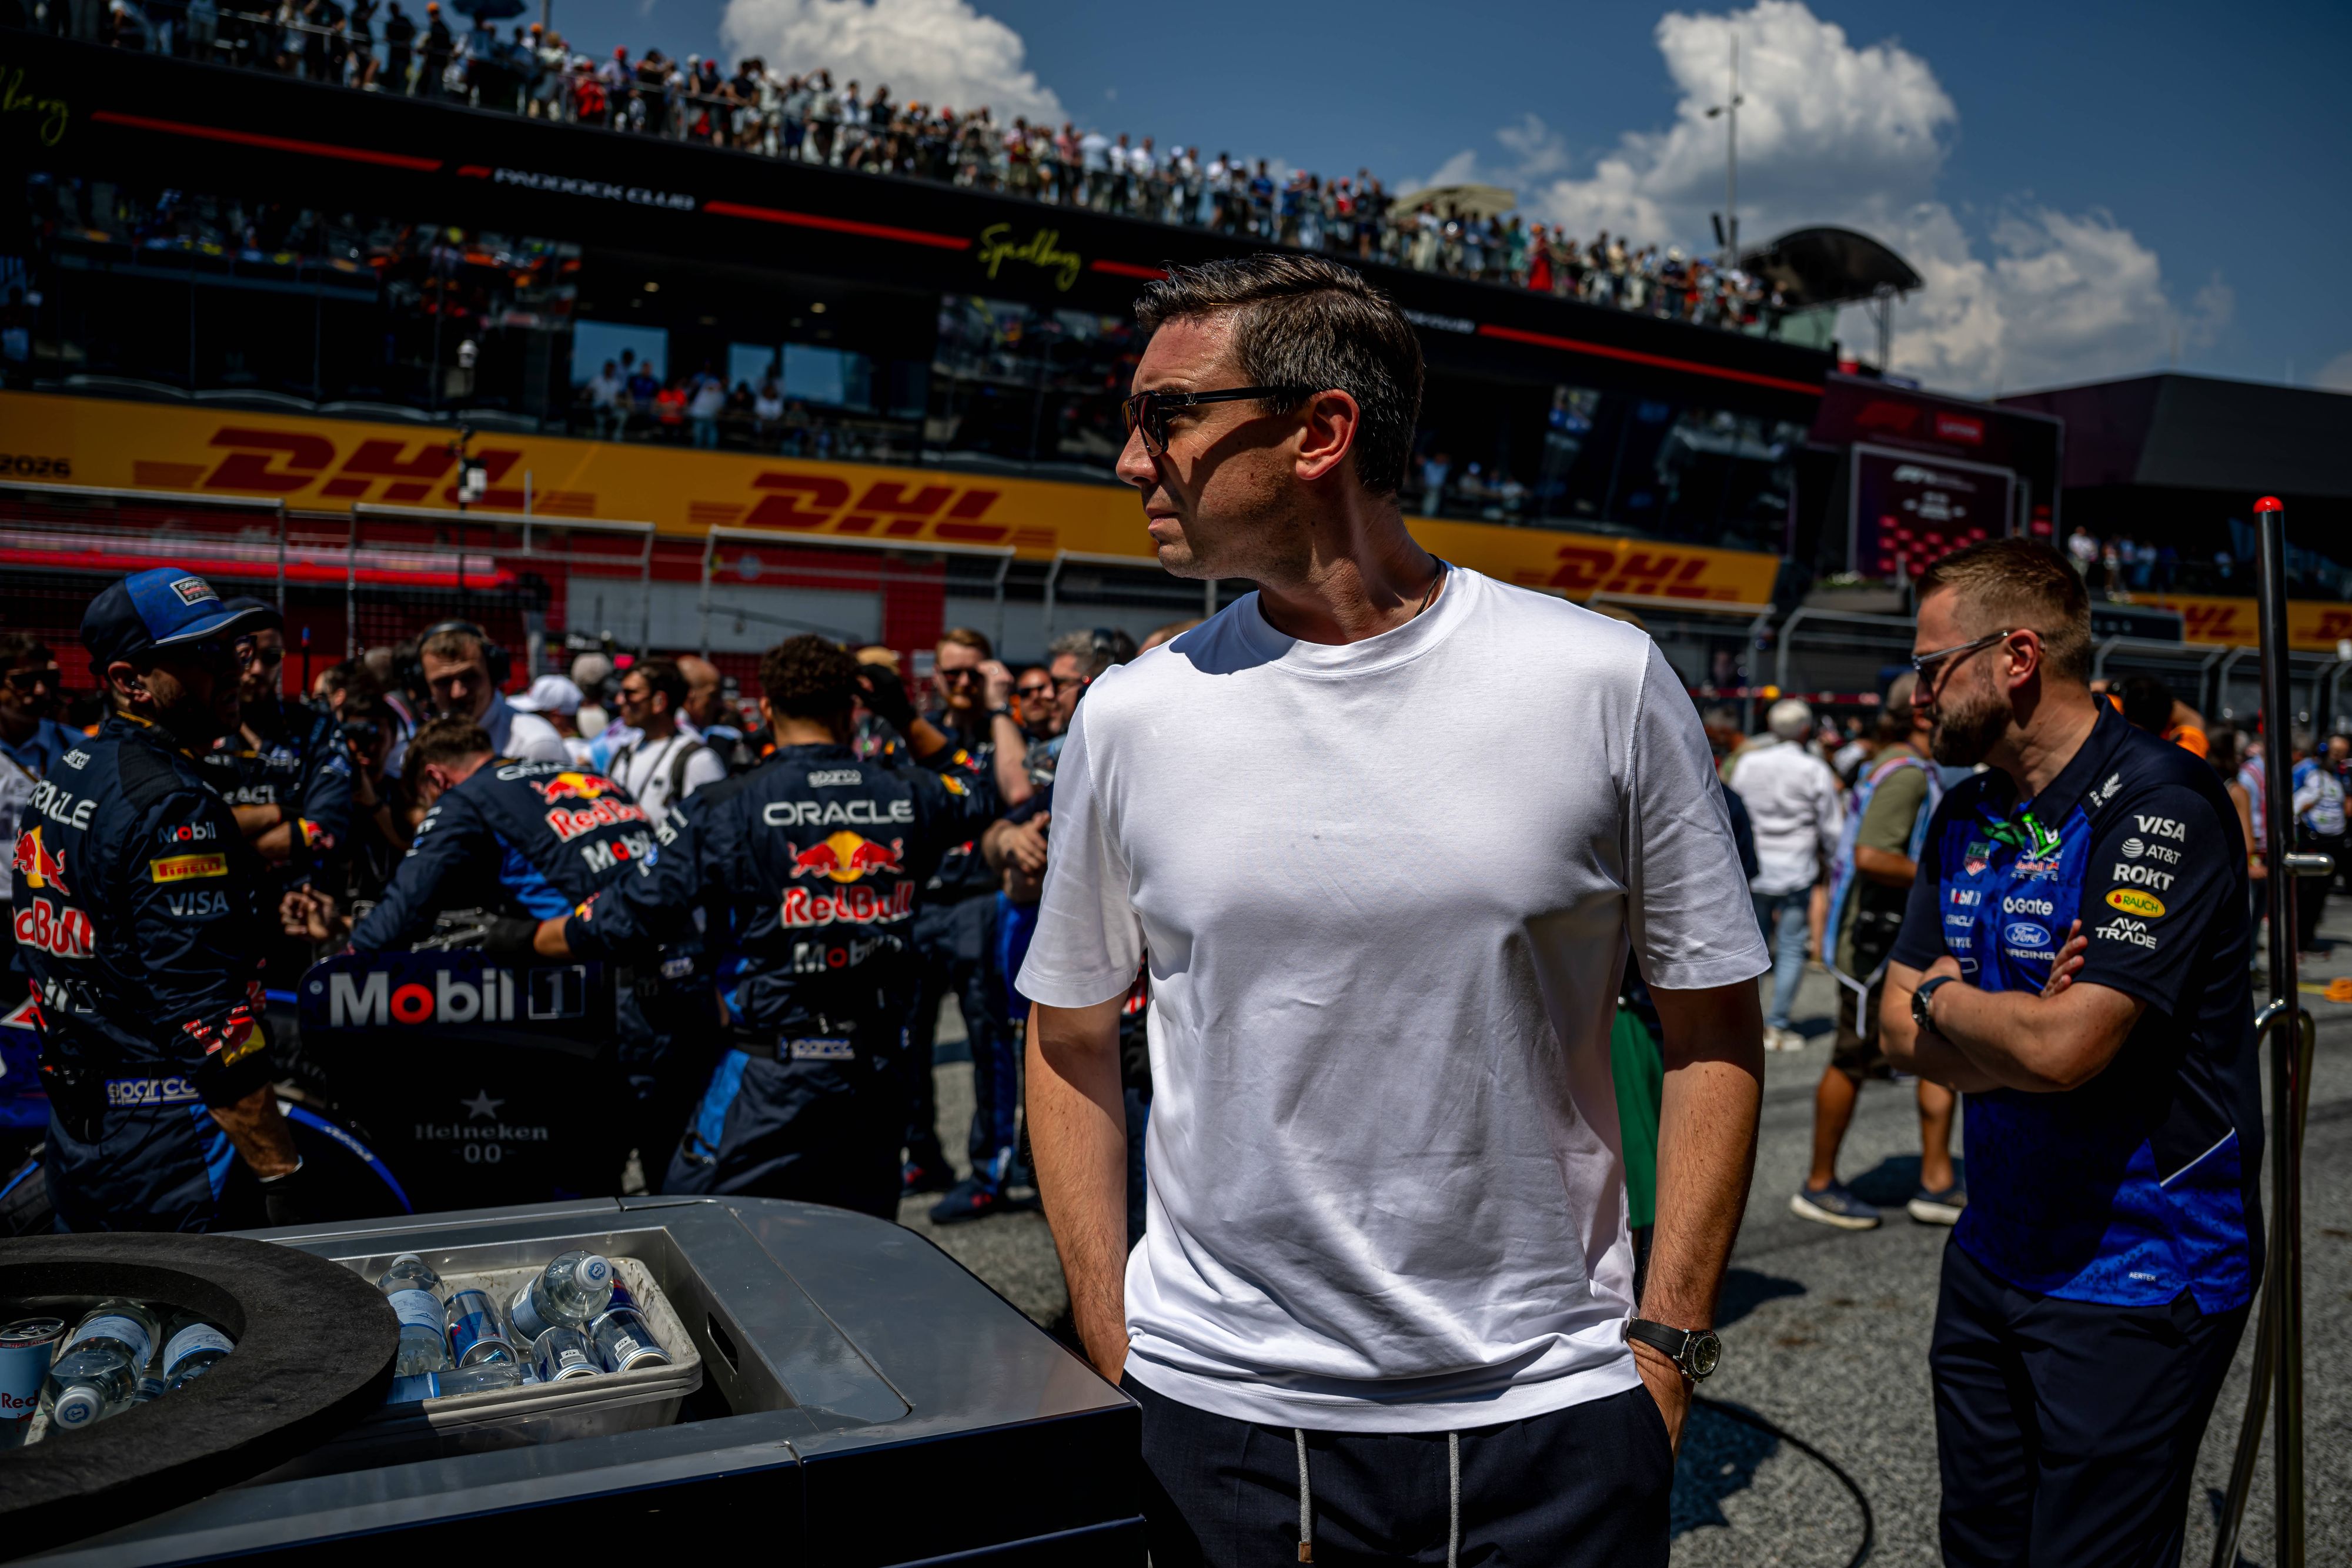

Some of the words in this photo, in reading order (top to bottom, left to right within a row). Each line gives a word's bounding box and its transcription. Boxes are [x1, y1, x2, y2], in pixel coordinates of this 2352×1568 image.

[625, 186, 696, 211] CLUB
[0, 454, 70, 478] 2026
[205, 428, 534, 507] DHL
[745, 473, 1006, 540] DHL
[1550, 547, 1709, 598] DHL
[763, 798, 915, 826] ORACLE
[158, 821, 217, 844] Mobil
[2133, 815, 2186, 842] VISA
[2145, 844, 2182, 865] AT&T
[158, 857, 222, 878] PIRELLI
[2113, 862, 2175, 891] ROKT
[163, 890, 231, 916] VISA
[2014, 898, 2054, 916] Gate
[2123, 894, 2159, 913] RAUCH
[2011, 925, 2042, 944] Ford
[2109, 917, 2147, 933] AVA
[2094, 927, 2157, 950] TRADE
[329, 967, 515, 1028] Mobil
[414, 1122, 550, 1141] Heineken
[2, 1390, 39, 1409] Red
